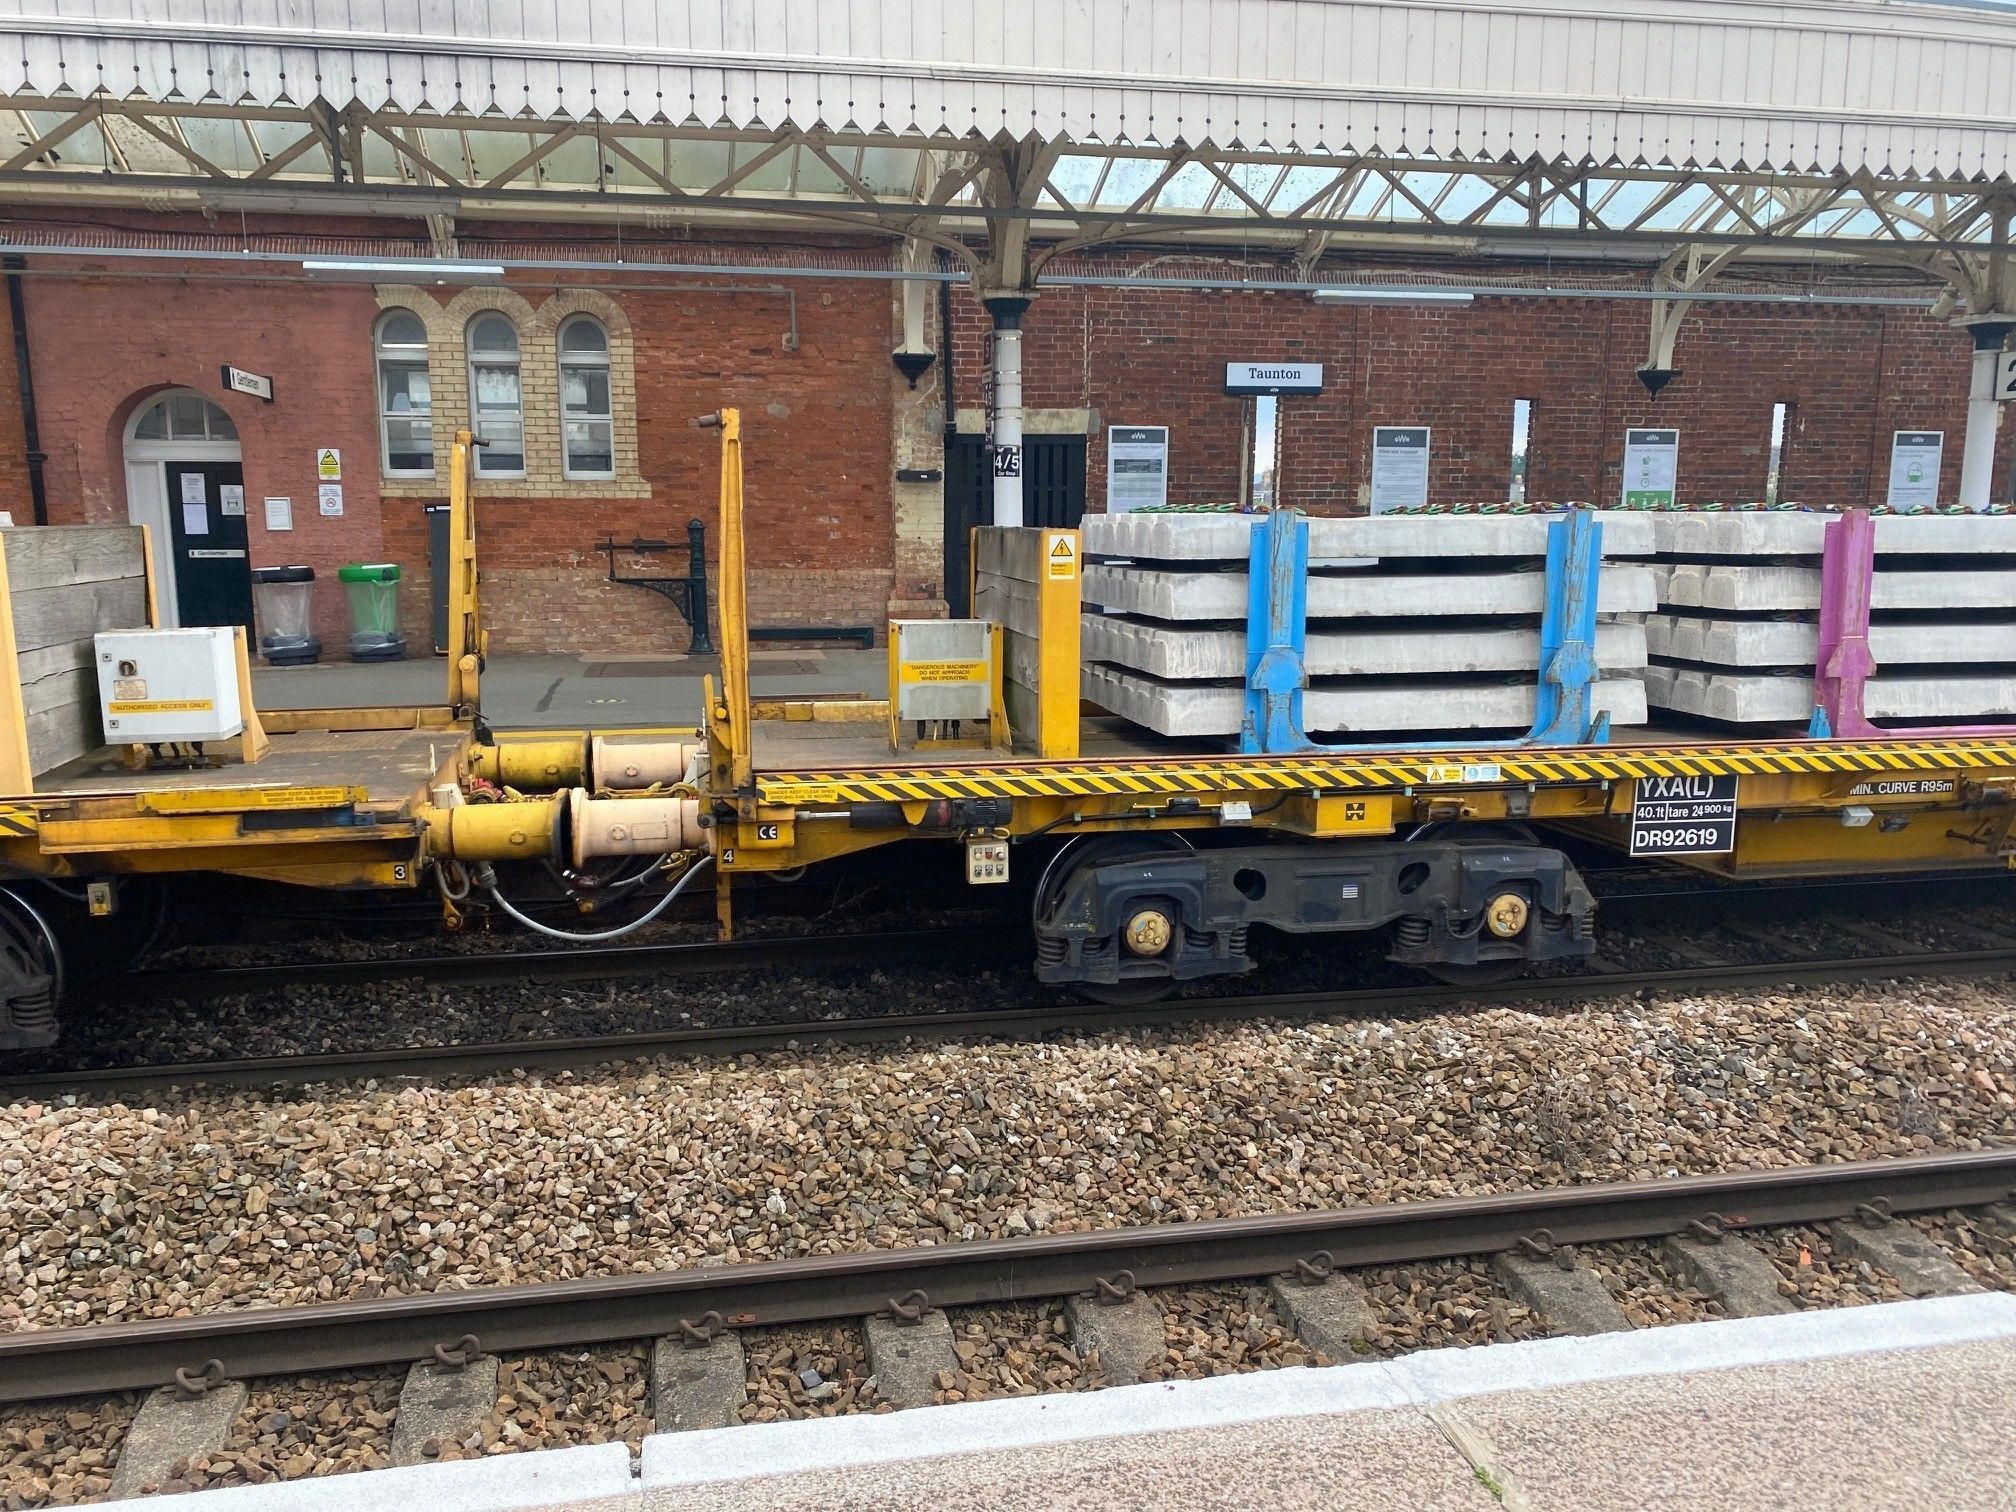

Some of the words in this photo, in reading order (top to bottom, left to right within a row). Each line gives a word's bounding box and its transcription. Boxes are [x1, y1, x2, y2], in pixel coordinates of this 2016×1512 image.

[1248, 367, 1301, 379] Taunton
[1394, 434, 1410, 443] GWR
[995, 454, 1020, 470] 4/5
[1641, 776, 1714, 799] YXA(L)
[1849, 784, 1874, 795] MIN.
[1878, 781, 1917, 794] CURVE
[1920, 780, 1953, 792] R95m
[1637, 806, 1665, 818] 40.1t
[1668, 807, 1689, 818] tare
[1722, 805, 1732, 813] kg
[759, 826, 777, 839] CE
[1635, 828, 1718, 847] DR92619
[723, 849, 734, 863] 4
[395, 866, 406, 879] 3
